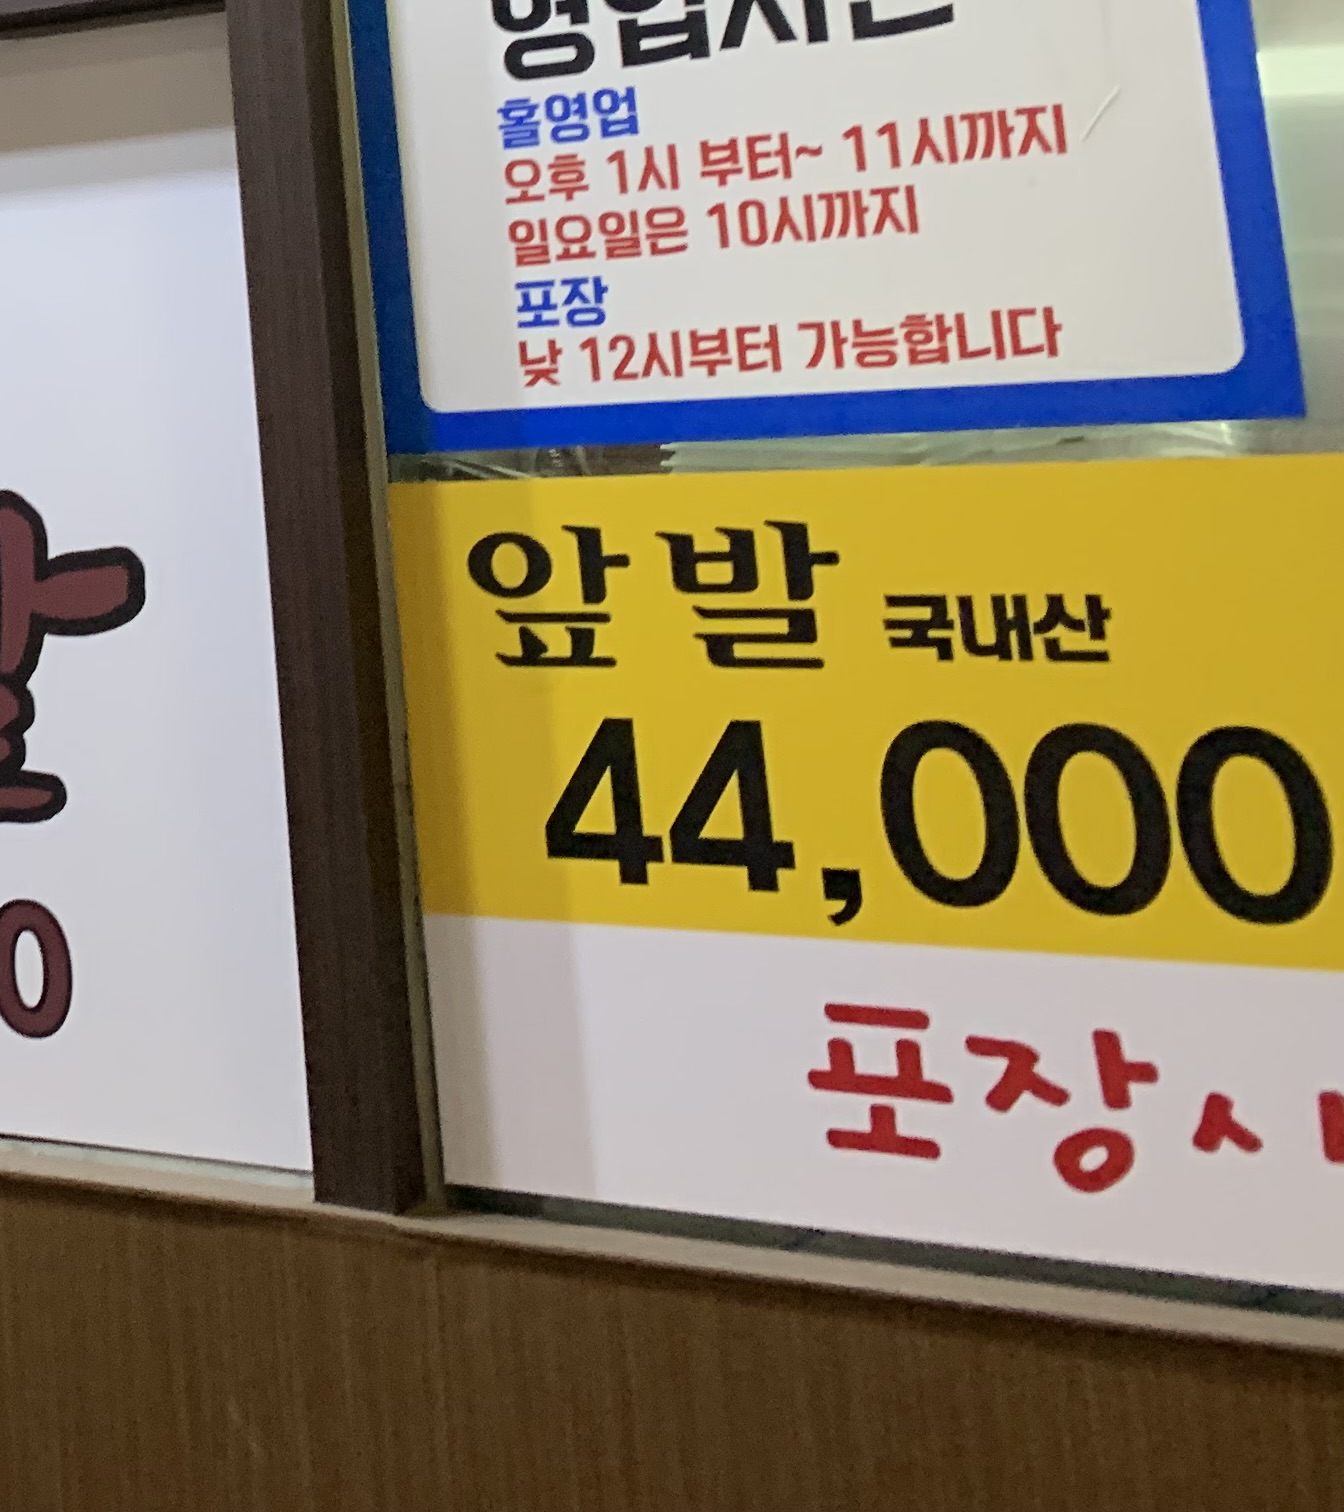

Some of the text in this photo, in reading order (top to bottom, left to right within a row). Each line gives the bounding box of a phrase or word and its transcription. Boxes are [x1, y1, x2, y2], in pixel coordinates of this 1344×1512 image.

[497, 87, 641, 150] 홀영업
[503, 103, 1069, 206] 오후 1시 부터~ 11시까지
[508, 184, 921, 268] 일요일은 10시까지
[513, 276, 609, 330] 포장
[518, 306, 1064, 389] 낮 12시부터 가능합니다
[883, 593, 1113, 663] 국내산
[544, 716, 1334, 928] 44,000
